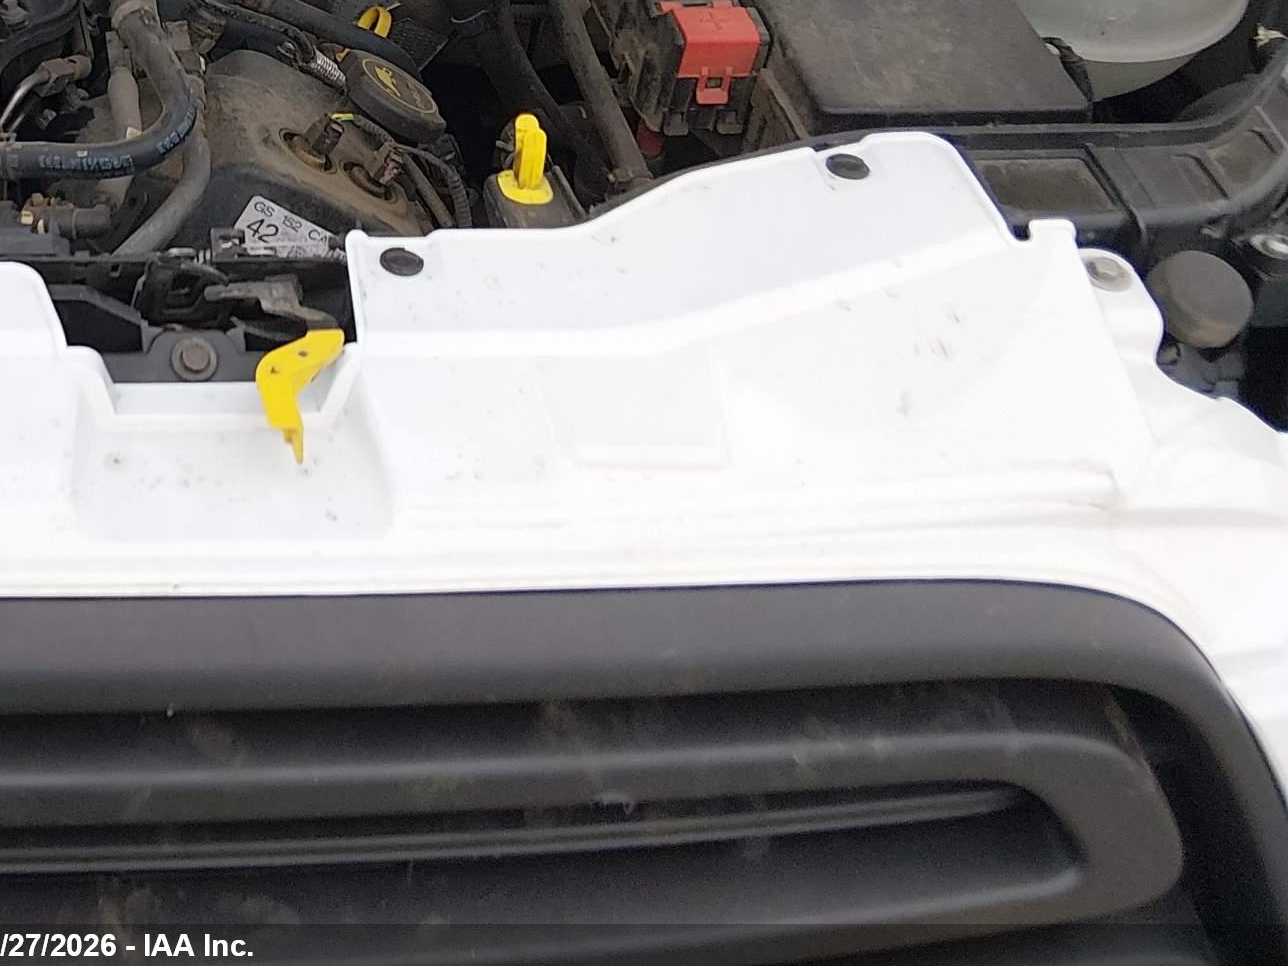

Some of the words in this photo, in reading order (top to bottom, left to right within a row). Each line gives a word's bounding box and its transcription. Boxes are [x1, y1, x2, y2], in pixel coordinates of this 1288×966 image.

[246, 218, 280, 244] 42
[253, 201, 275, 218] GS
[282, 215, 303, 233] 152
